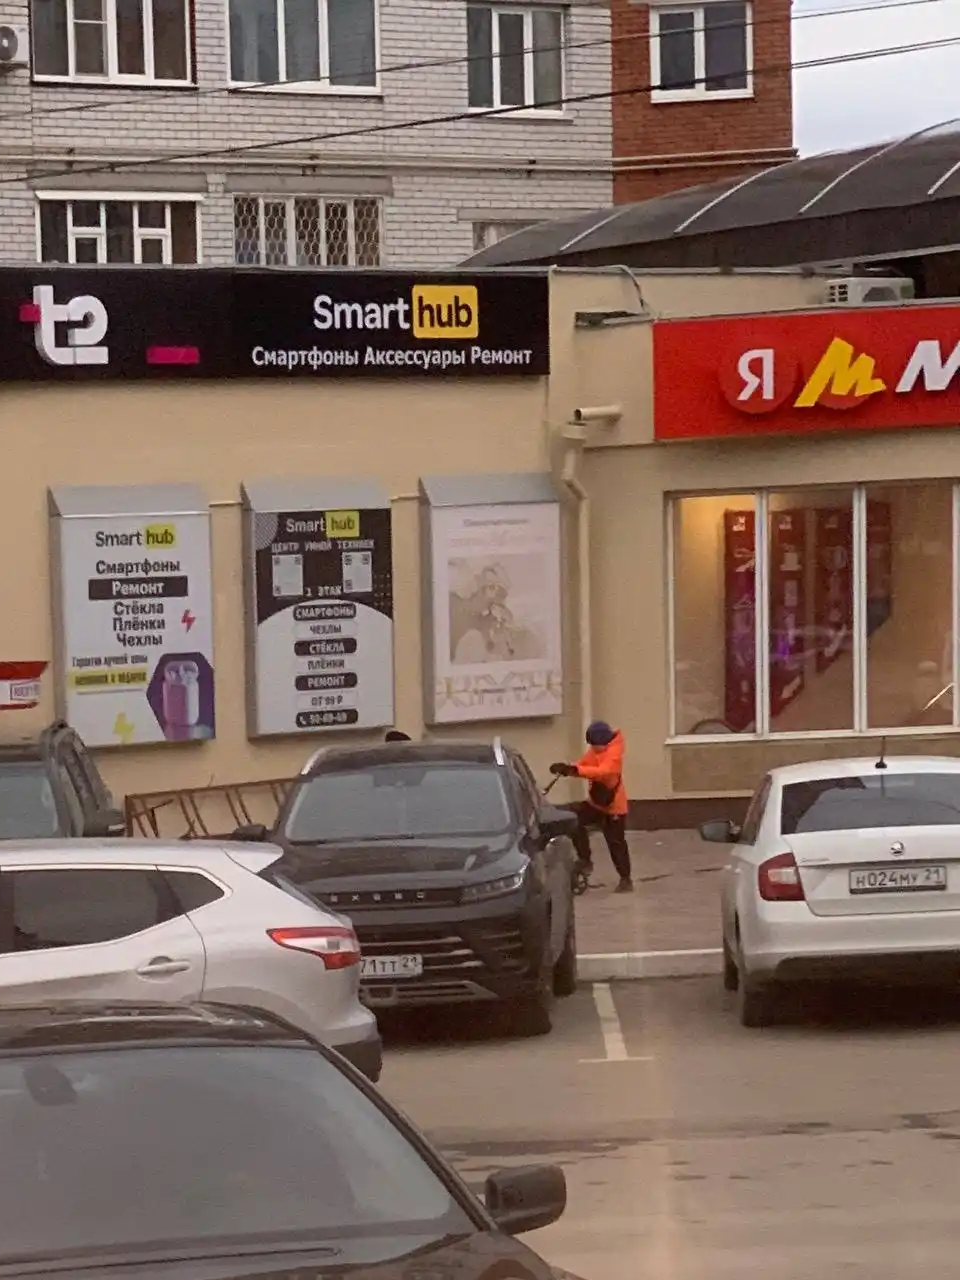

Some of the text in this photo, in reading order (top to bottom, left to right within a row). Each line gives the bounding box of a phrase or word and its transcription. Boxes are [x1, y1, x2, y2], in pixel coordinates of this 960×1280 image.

[313, 294, 473, 330] Smart hub
[33, 284, 109, 366] t2
[251, 345, 533, 369] Смартфоны Аксессуары Ремонт
[737, 348, 775, 401] Я
[286, 516, 355, 533] Smart hub
[95, 528, 174, 547] Smart hub
[96, 558, 181, 576] Смартфоны
[111, 581, 165, 596] Ремонт
[317, 585, 342, 597] ЭТАЖ
[113, 600, 164, 616] Стёкла
[295, 606, 354, 619] СМАРТФОНЫ
[112, 616, 166, 632] Плёнки
[309, 624, 342, 635] ЧЕХЛЫ
[116, 632, 163, 648] Чехлы
[309, 641, 345, 654] СТЁКЛА
[307, 658, 345, 670] ПЛЁНКИ
[307, 676, 345, 689] РЕМОНТ
[856, 868, 941, 887] Н024МУ 21
